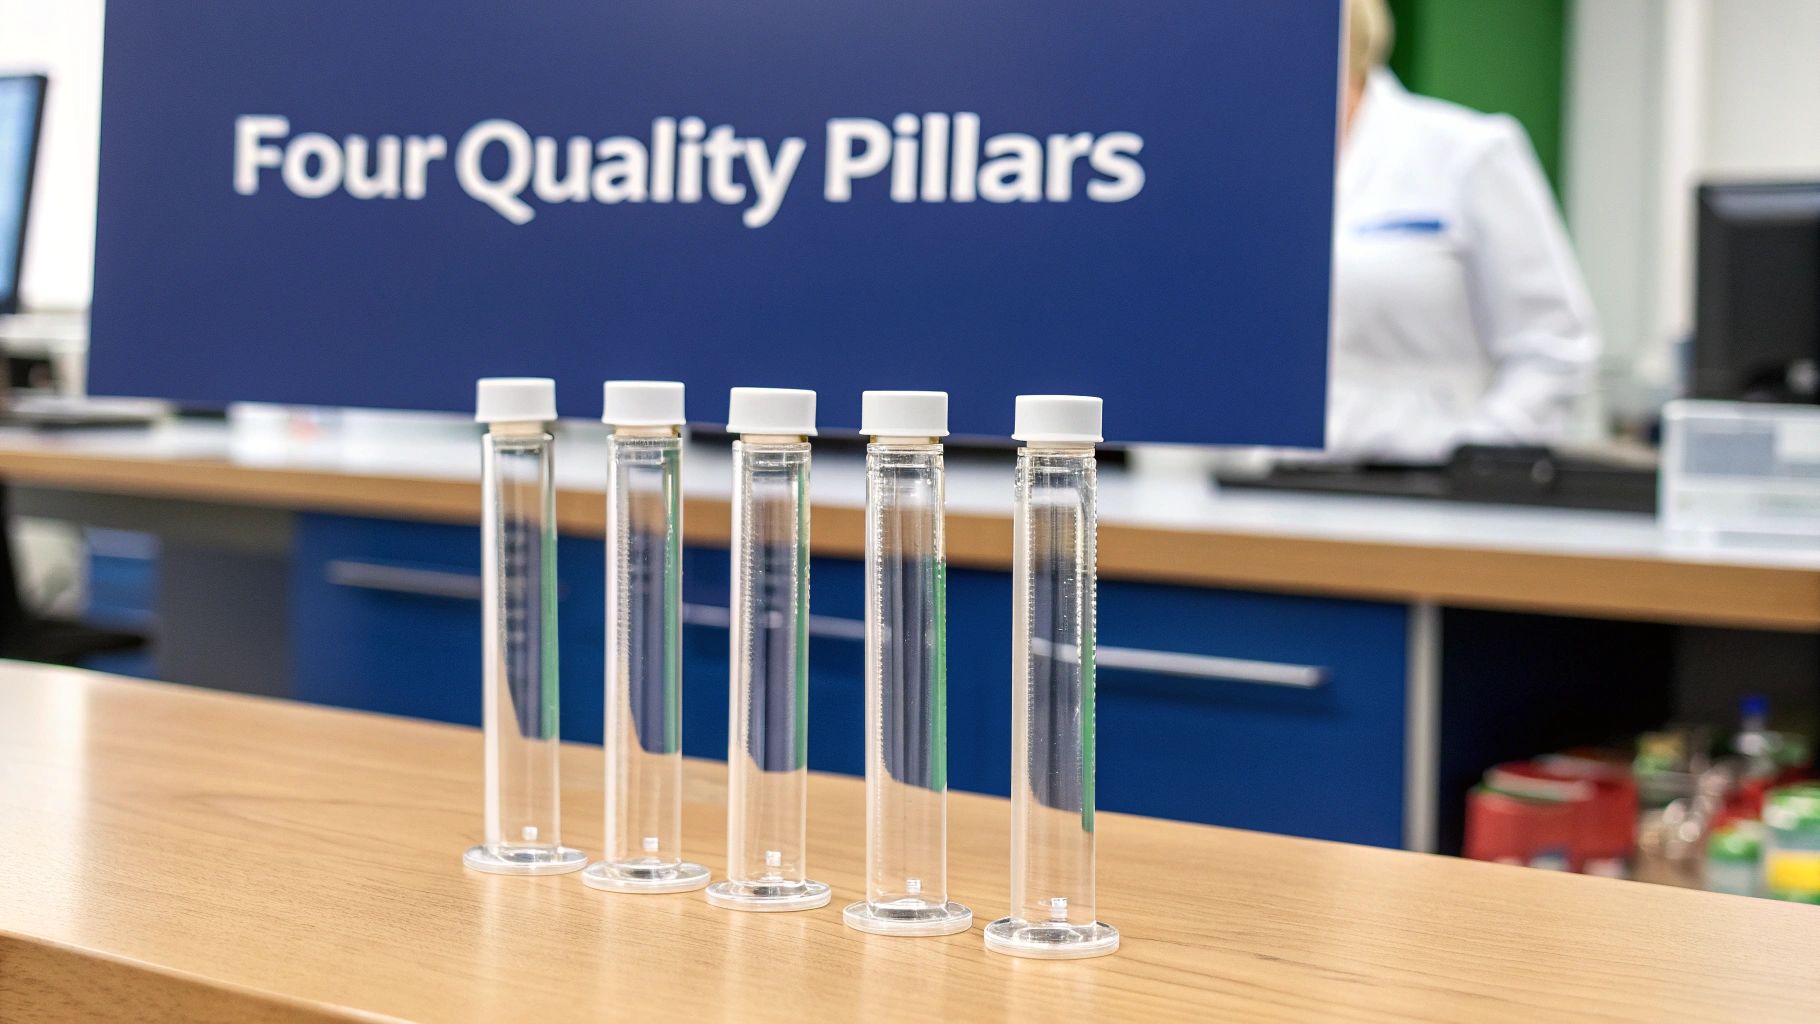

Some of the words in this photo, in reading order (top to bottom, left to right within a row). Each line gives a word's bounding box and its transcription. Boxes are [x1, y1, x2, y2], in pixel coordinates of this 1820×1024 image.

[234, 115, 446, 200] Four
[456, 117, 806, 228] Quality
[824, 112, 1145, 203] Pillars
